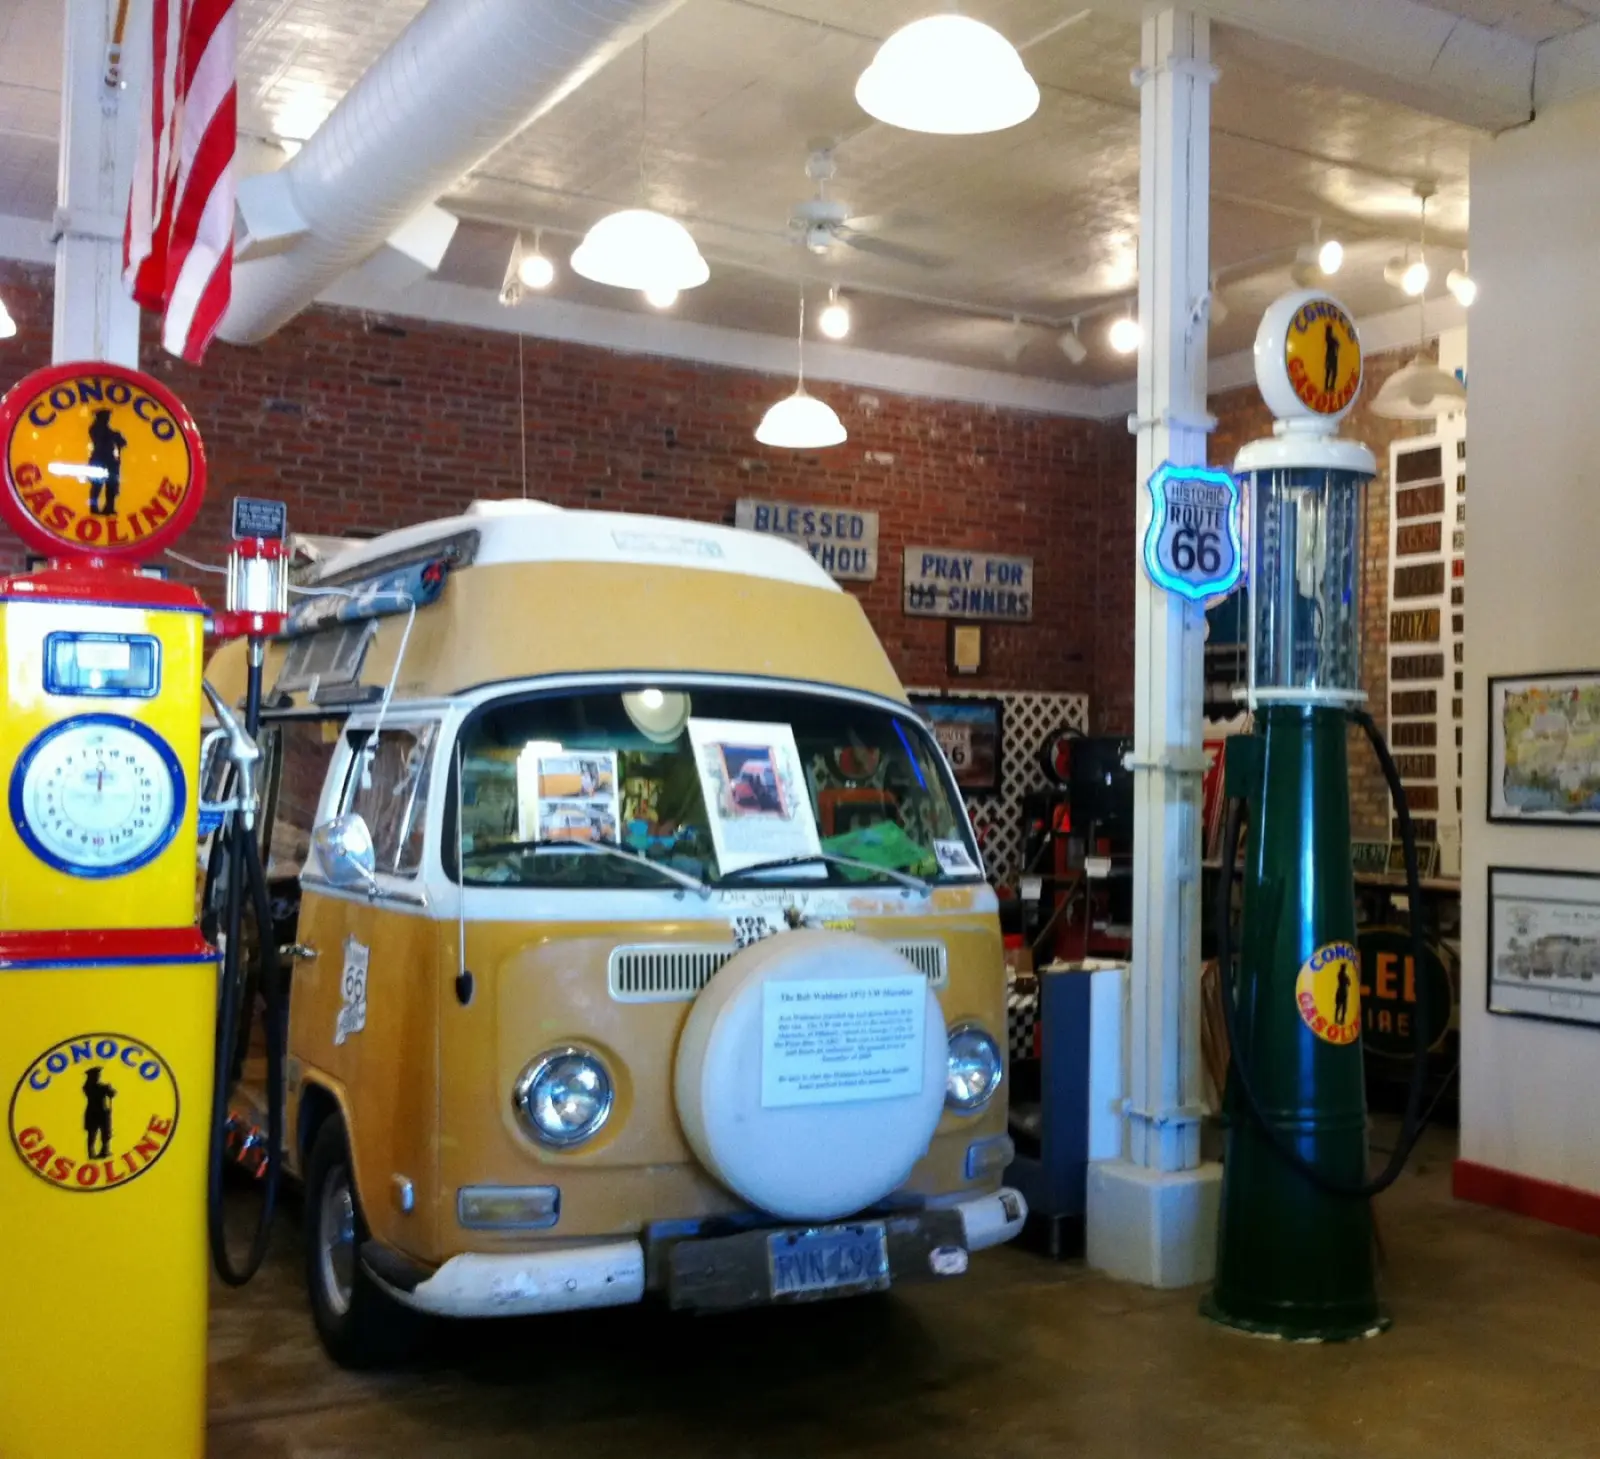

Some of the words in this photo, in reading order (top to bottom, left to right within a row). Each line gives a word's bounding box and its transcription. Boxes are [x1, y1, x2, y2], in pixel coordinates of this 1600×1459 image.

[1295, 302, 1356, 344] CONOCO
[28, 379, 176, 442] CONOCO
[15, 462, 182, 544] GASOLINE
[1171, 484, 1225, 505] HISTORIC
[754, 504, 864, 540] BLESSED
[1170, 505, 1225, 529] ROUTE
[920, 553, 973, 583] PRAY
[985, 560, 1024, 587] FOR
[1171, 529, 1221, 574] 66
[947, 586, 1030, 616] SINNERS
[345, 965, 364, 1001] 66
[29, 1039, 162, 1091] CONOCO
[18, 1113, 173, 1187] GASOLINE
